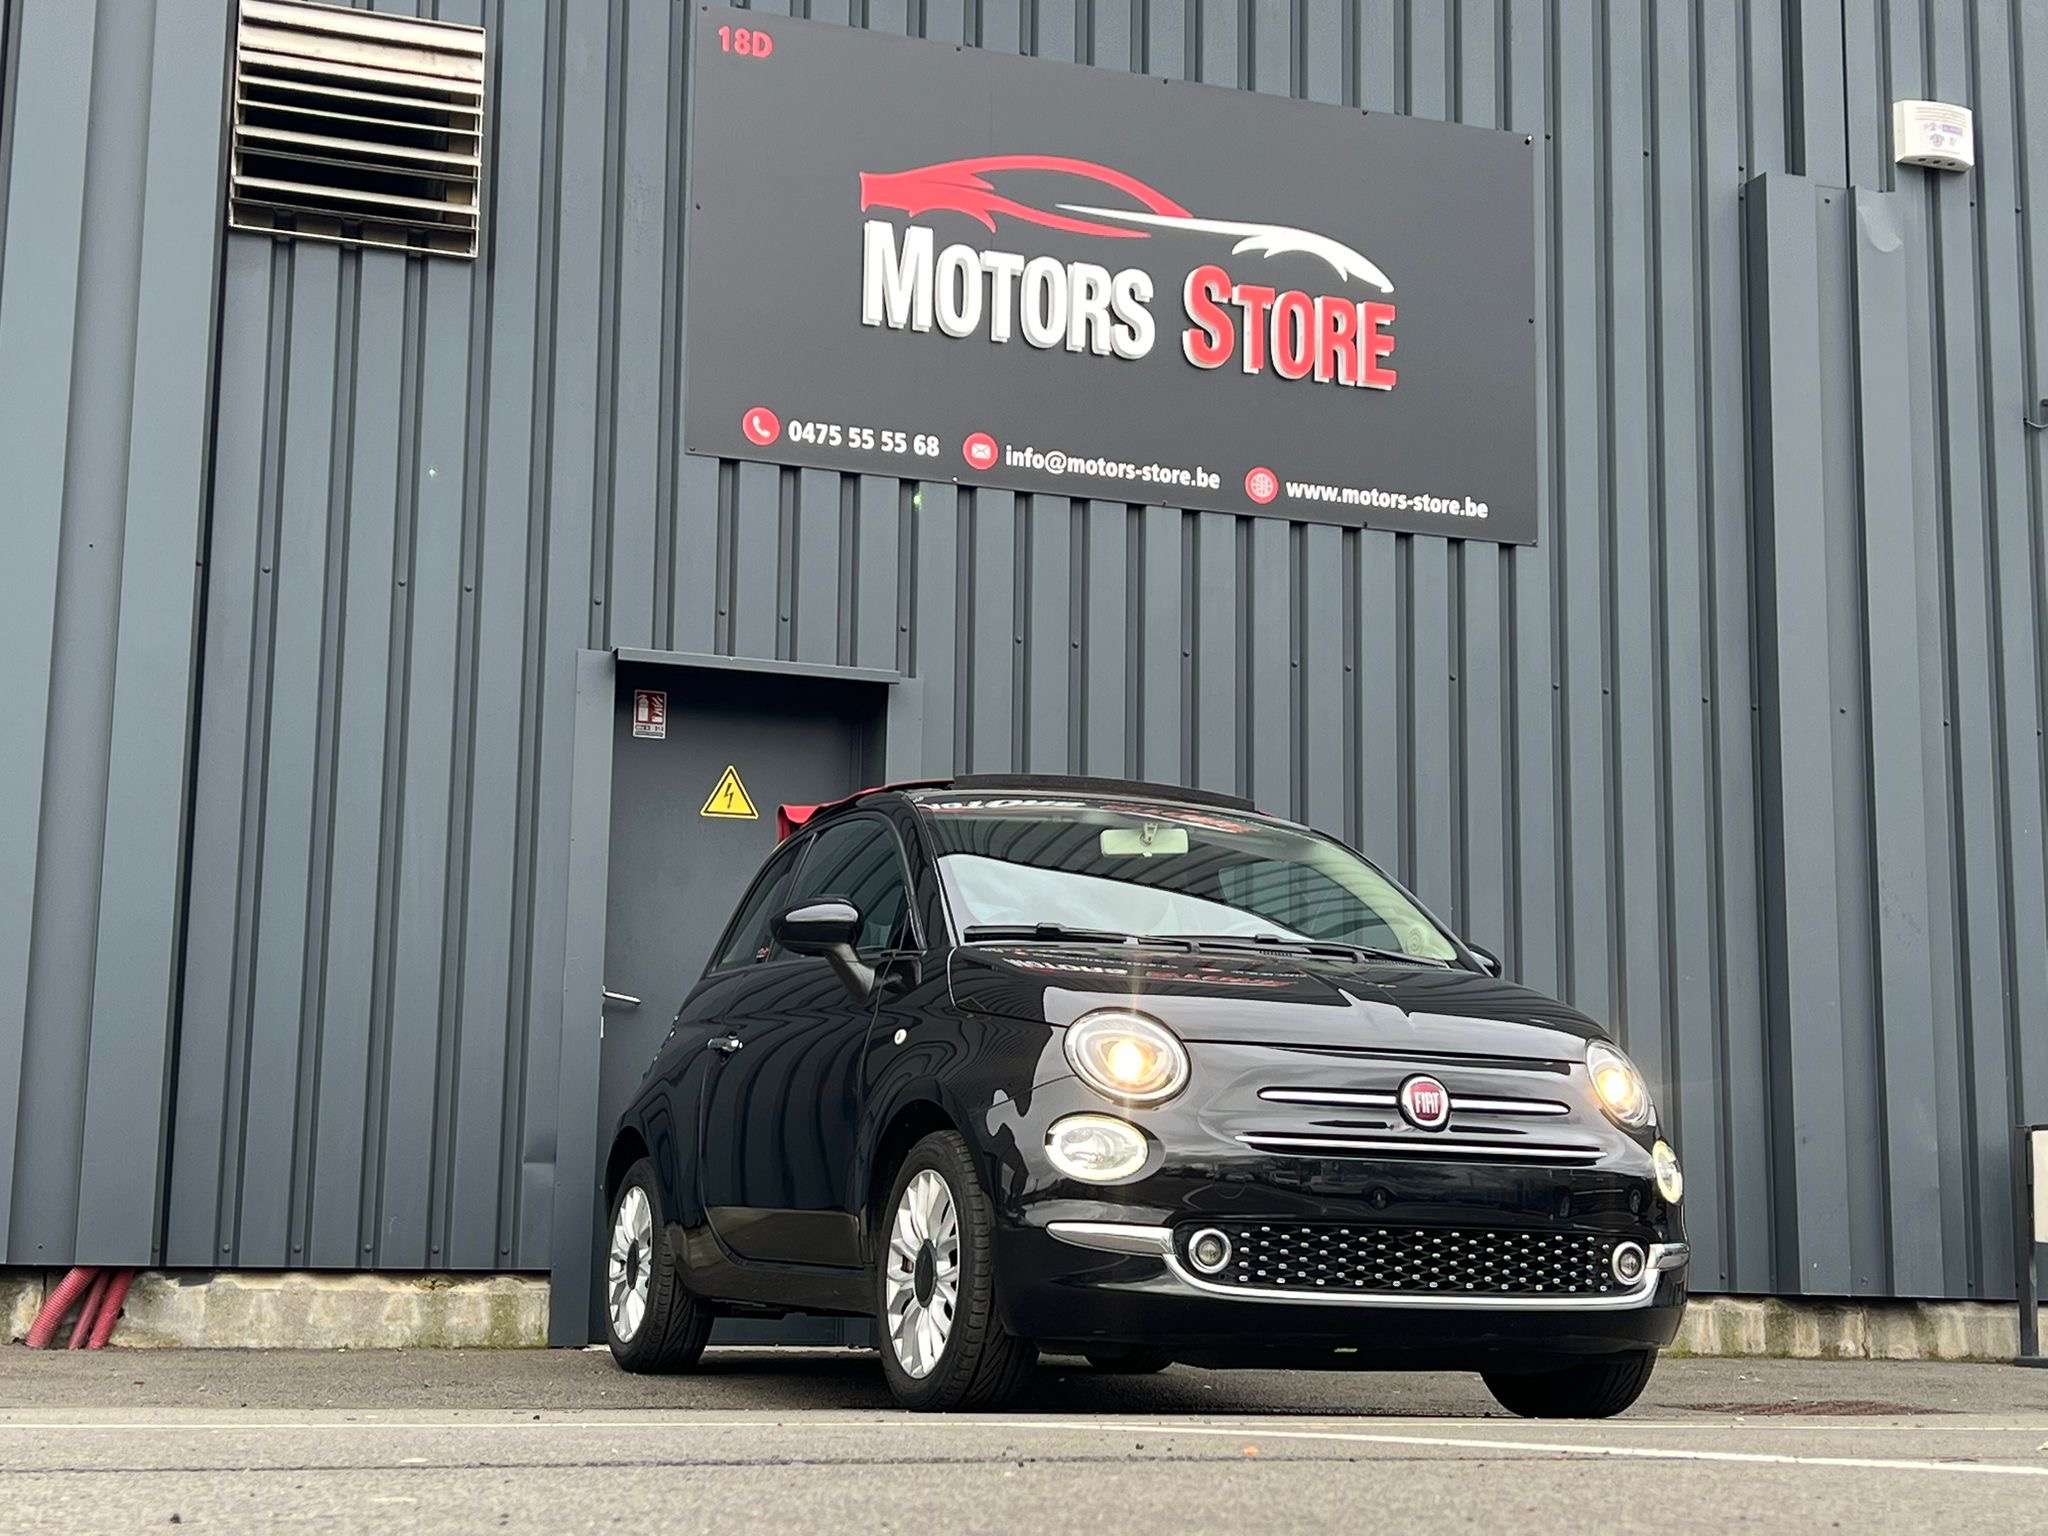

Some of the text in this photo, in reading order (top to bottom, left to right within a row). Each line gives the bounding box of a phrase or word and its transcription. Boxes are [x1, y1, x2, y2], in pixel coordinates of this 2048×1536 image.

[718, 25, 774, 60] 18D
[860, 218, 1398, 392] MOTORS STORE
[788, 420, 940, 457] 0475 55 55 68
[1005, 446, 1221, 490] info@motors-store.be
[1286, 481, 1489, 518] www.motors-store.be
[1415, 1091, 1440, 1114] FIAT
